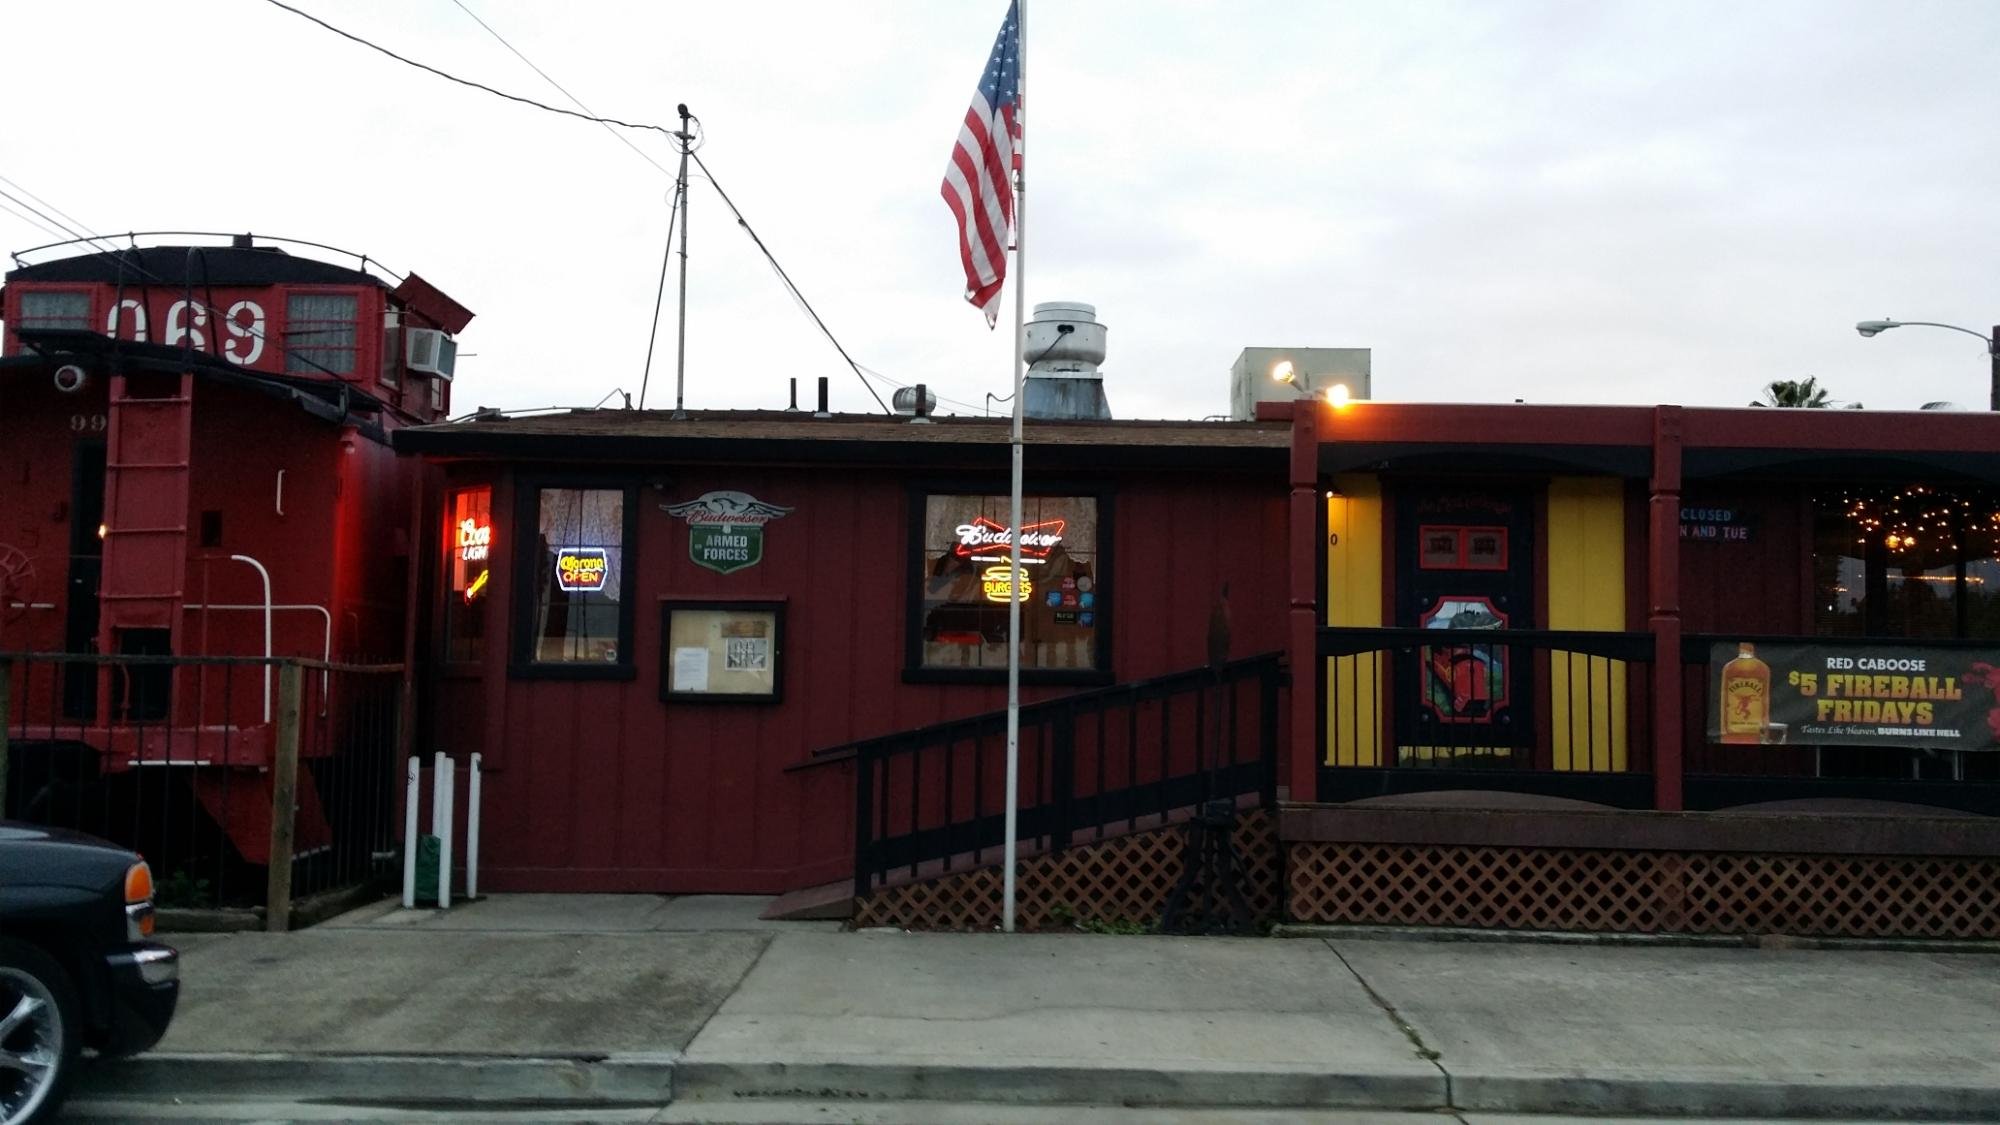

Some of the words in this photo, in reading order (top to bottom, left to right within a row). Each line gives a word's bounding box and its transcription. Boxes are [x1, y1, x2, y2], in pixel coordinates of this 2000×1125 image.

[686, 510, 769, 524] Budweiser
[1680, 508, 1732, 521] CLOSED
[956, 524, 1062, 547] Budeiser
[1692, 526, 1717, 537] AND
[1723, 527, 1748, 539] TUE
[706, 535, 748, 548] ARMED
[703, 548, 749, 561] FORCES
[560, 555, 604, 571] Corona
[563, 571, 598, 582] OPEN
[984, 581, 1032, 593] BURGRS
[1827, 657, 1854, 670] RED
[1857, 658, 1926, 671] CABOOSE
[1788, 670, 1818, 697] $5
[1827, 674, 1962, 700] FIREBALL
[1817, 699, 1933, 725] FRIDAYS
[1801, 725, 1826, 734] Tastes
[1827, 726, 1844, 735] Like
[1877, 727, 1912, 736] BURNS
[1913, 728, 1936, 736] LIKE
[1936, 729, 1961, 737] HELL
